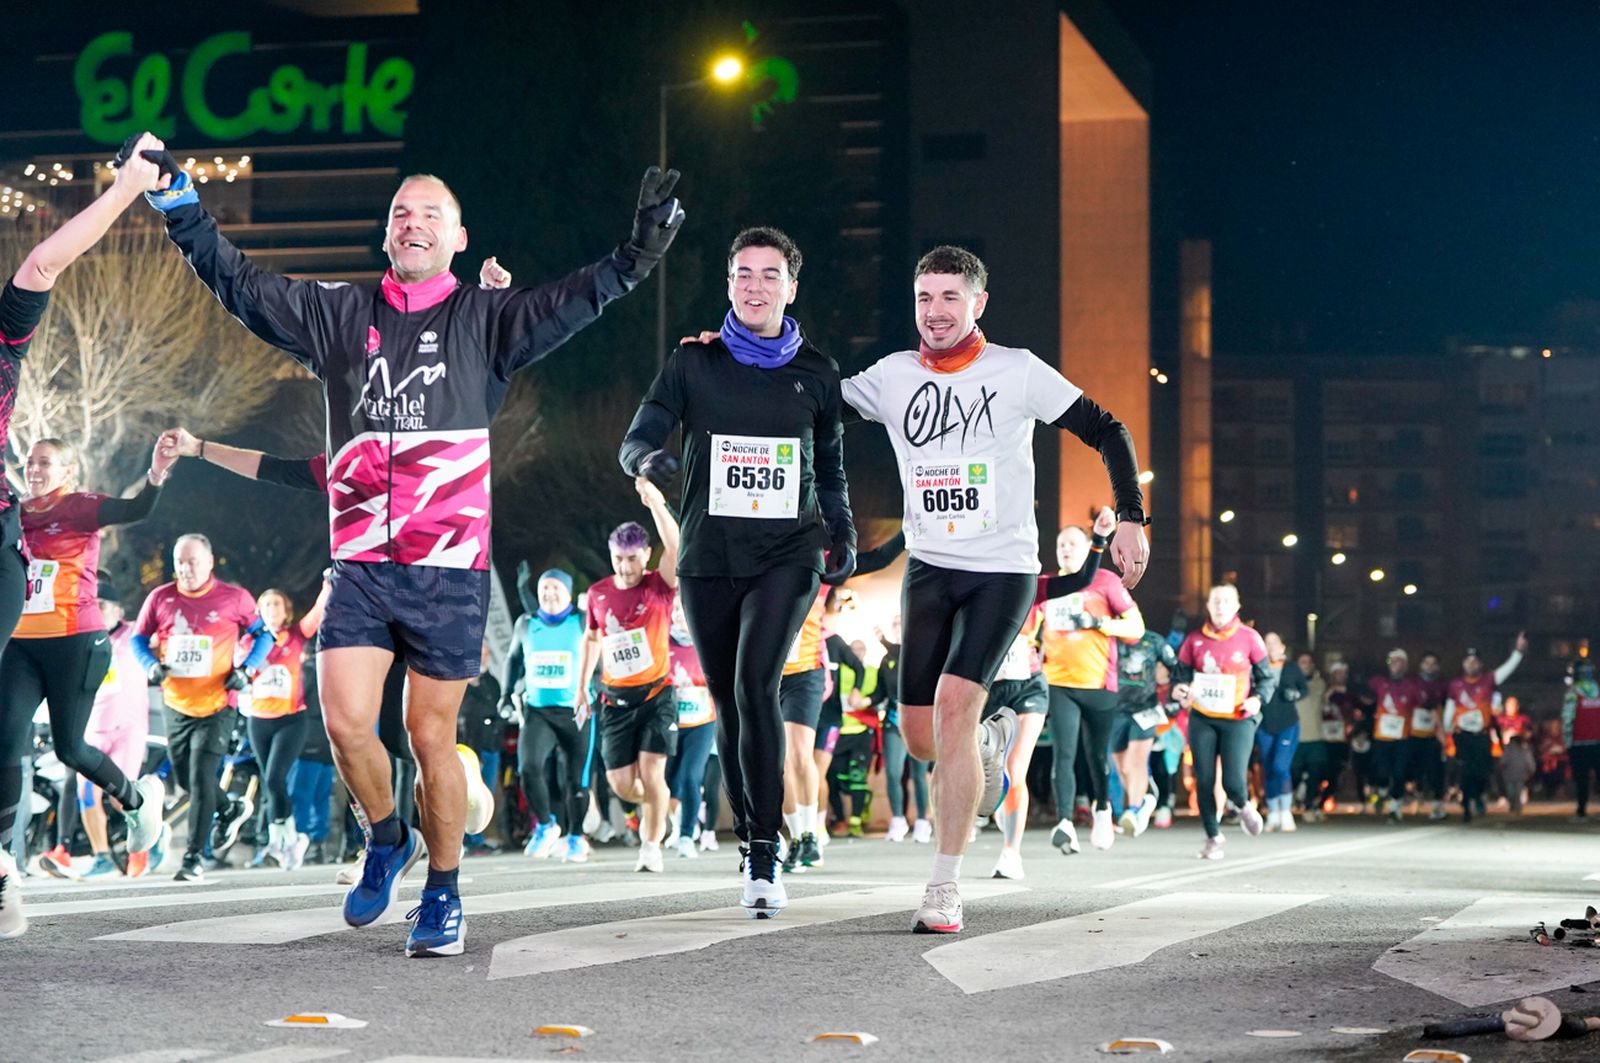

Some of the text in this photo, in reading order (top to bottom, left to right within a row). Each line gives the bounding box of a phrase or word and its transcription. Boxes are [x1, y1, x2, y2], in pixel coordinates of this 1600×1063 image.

[75, 31, 415, 142] El Corte
[904, 381, 997, 454] OLYX
[732, 446, 769, 455] NOCHE DE
[721, 455, 738, 463] SAN
[727, 465, 786, 490] 6536
[925, 467, 960, 476] NOCHE DE
[916, 479, 931, 488] SAN
[923, 487, 979, 512] 6058
[613, 646, 640, 662] 1489
